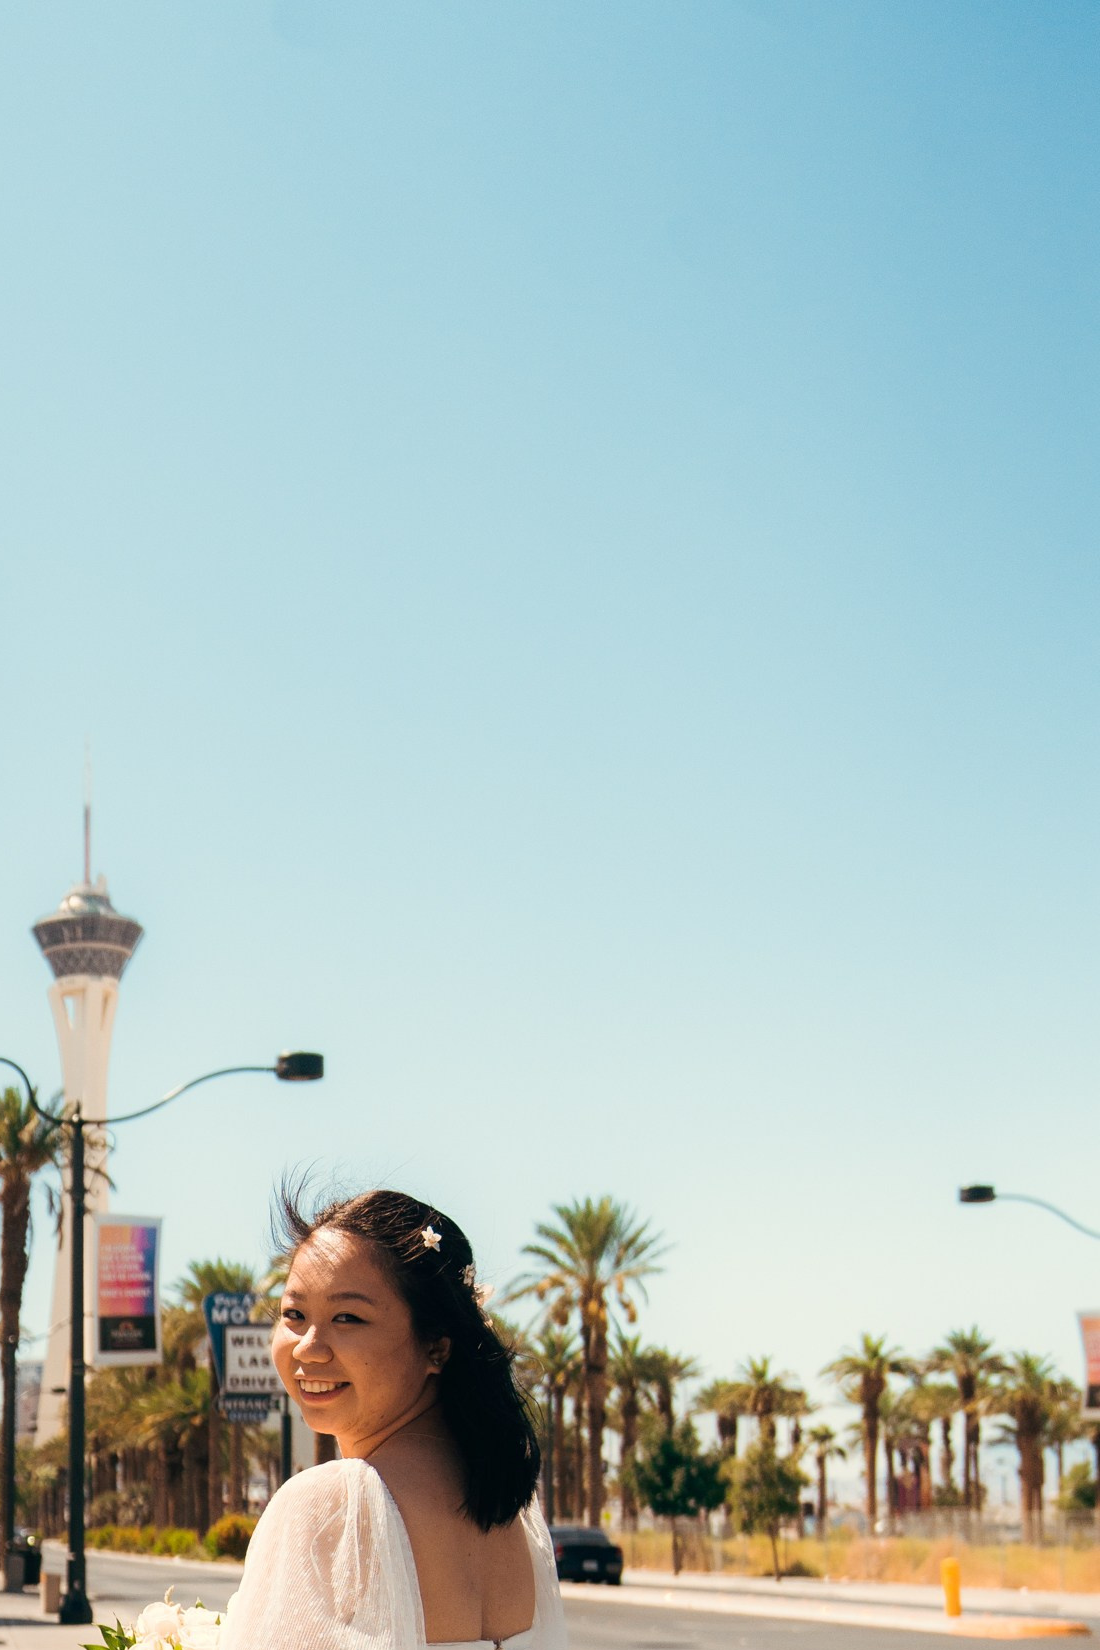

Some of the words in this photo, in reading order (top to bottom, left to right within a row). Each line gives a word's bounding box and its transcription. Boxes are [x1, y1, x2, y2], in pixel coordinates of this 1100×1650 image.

[211, 1306, 246, 1325] MO
[231, 1336, 266, 1348] WEL
[229, 1376, 278, 1389] DRIVE
